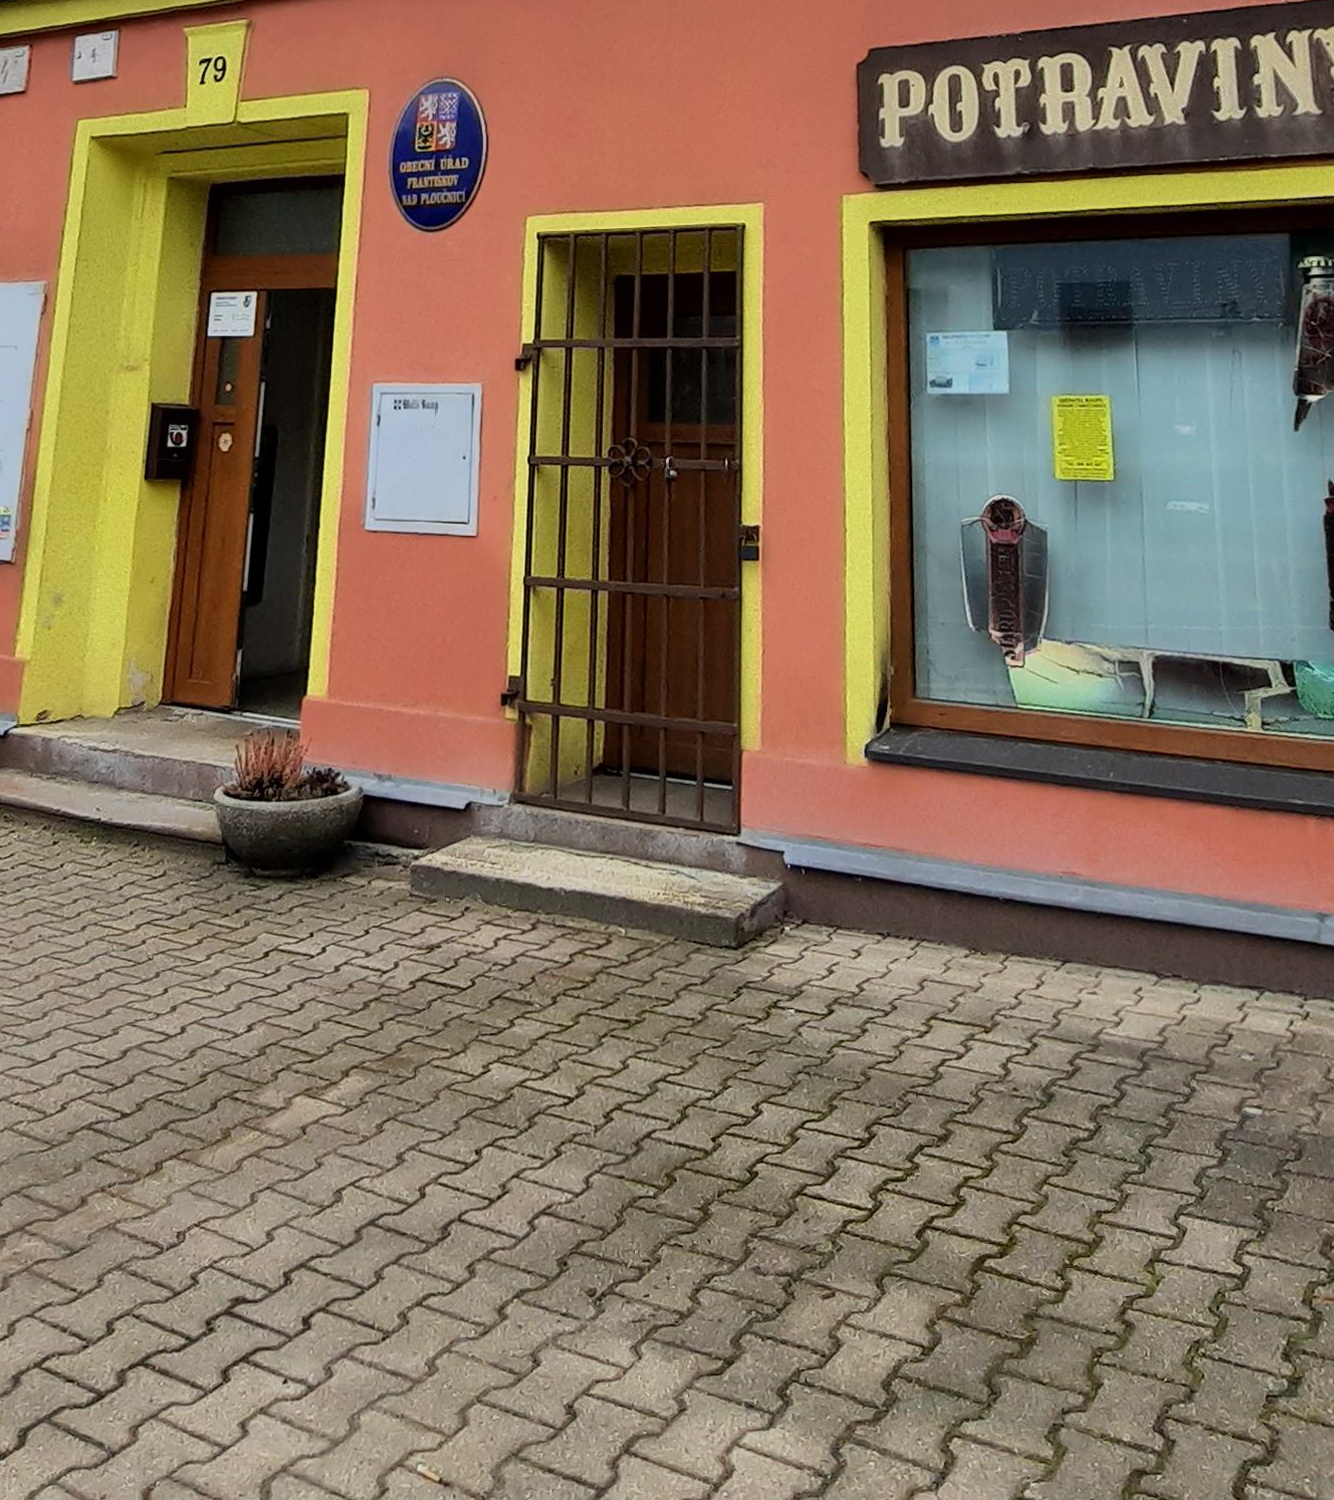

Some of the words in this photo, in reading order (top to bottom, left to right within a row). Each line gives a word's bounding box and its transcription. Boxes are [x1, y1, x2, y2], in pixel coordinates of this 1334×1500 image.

[198, 55, 227, 85] 79
[399, 155, 436, 173] OBECNÍ
[440, 154, 470, 170] ÚŘAD
